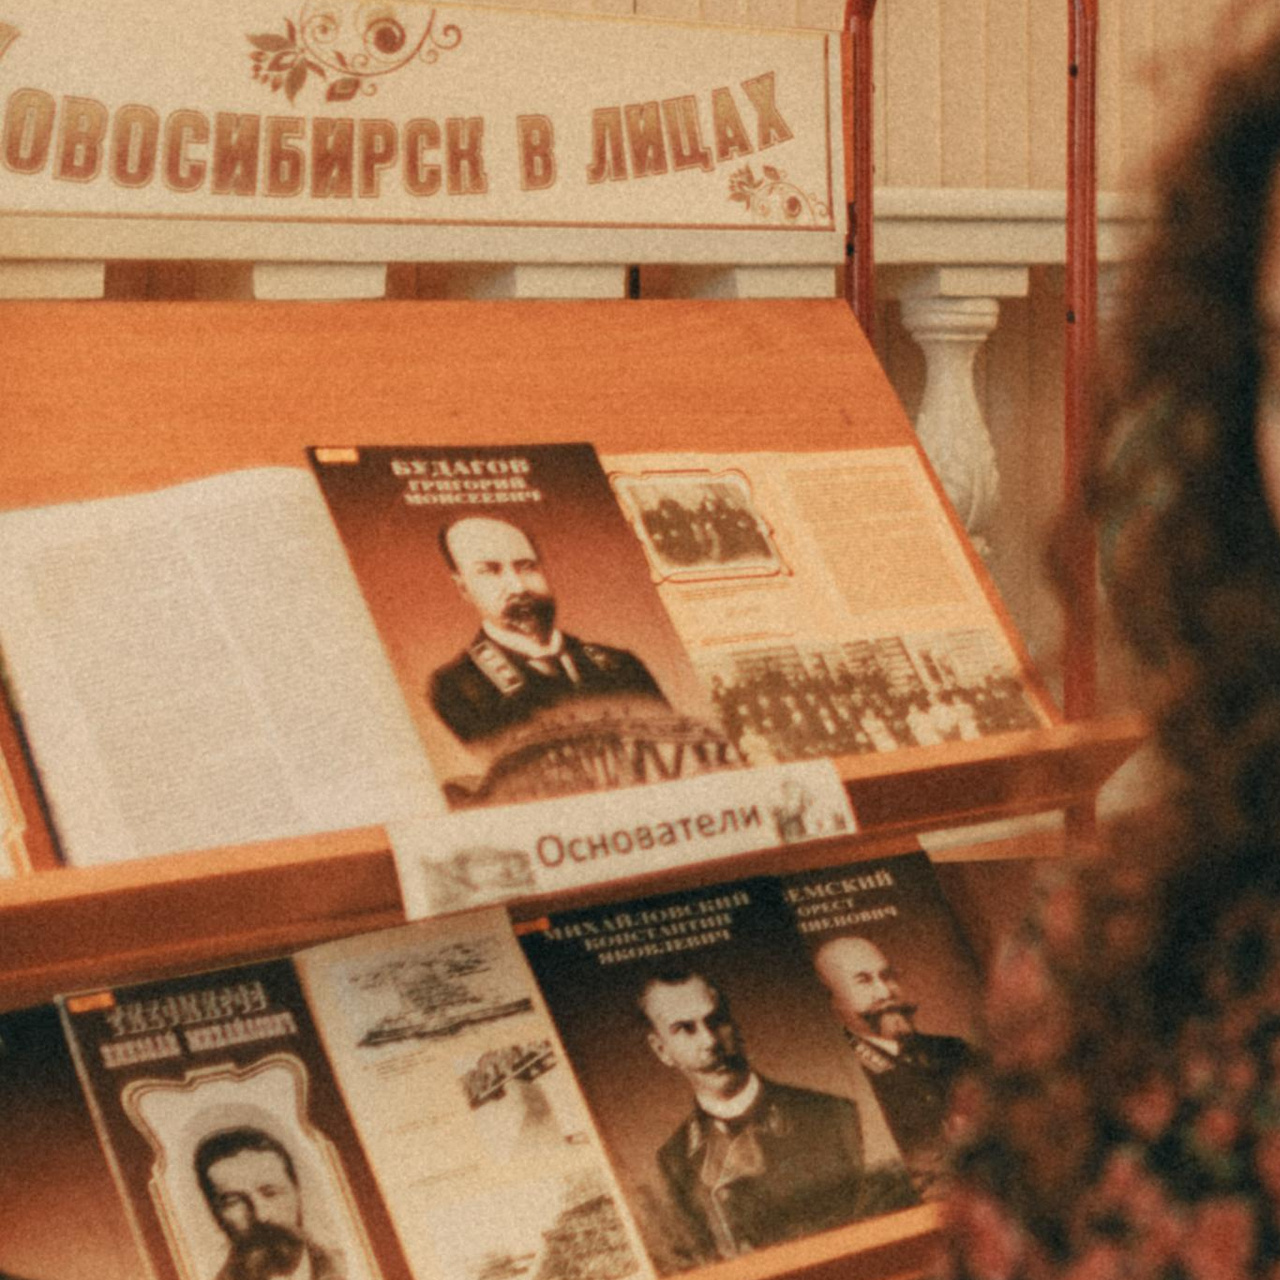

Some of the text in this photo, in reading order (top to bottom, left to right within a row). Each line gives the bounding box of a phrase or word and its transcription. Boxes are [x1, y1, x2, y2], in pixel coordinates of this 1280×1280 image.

[2, 69, 794, 199] ОВОСИБИРСК В ЛИЦАХ
[391, 458, 530, 477] БУДАГОВ
[537, 804, 763, 868] Основатели
[785, 867, 894, 902] ЕМСКИЙ
